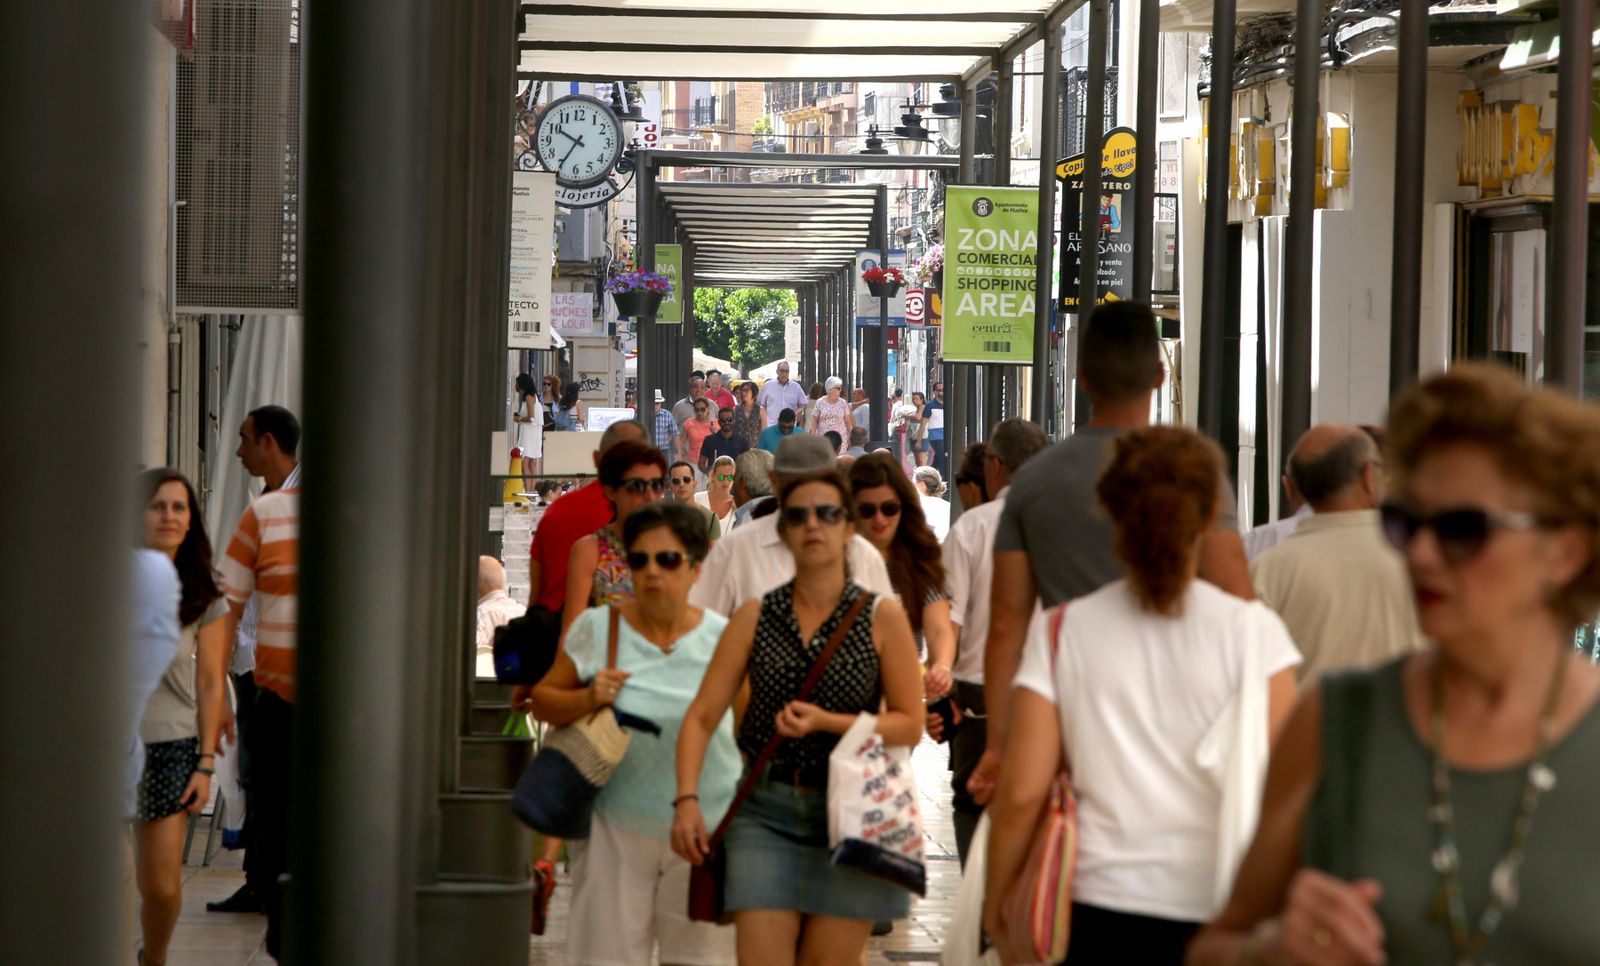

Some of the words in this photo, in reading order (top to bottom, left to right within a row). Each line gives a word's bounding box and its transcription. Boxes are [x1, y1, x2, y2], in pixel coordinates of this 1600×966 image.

[560, 112, 569, 124] 11
[574, 109, 586, 121] 12
[592, 114, 597, 126] 1
[549, 123, 562, 135] 10
[599, 124, 606, 135] 2
[545, 135, 552, 147] 9
[603, 138, 611, 150] 3
[548, 148, 555, 160] 8
[597, 153, 604, 165] 4
[1063, 160, 1083, 173] Copi
[1113, 146, 1136, 159] llave
[572, 164, 579, 175] 6
[586, 162, 593, 173] 5
[1071, 181, 1131, 190] ZATERO
[555, 187, 610, 201] elojeria
[958, 228, 1038, 252] ZONA
[1068, 232, 1082, 241] EL
[1067, 240, 1132, 254] ARSANO
[657, 264, 676, 274] NA
[957, 277, 1036, 291] SHOPPING
[1110, 278, 1123, 287] piel
[508, 301, 539, 310] TECTO
[555, 295, 575, 305] LAS
[955, 292, 1036, 318] AREA
[508, 309, 521, 317] SA
[551, 307, 587, 318] HUCHES
[551, 319, 560, 329] E
[562, 319, 585, 329] LOLA
